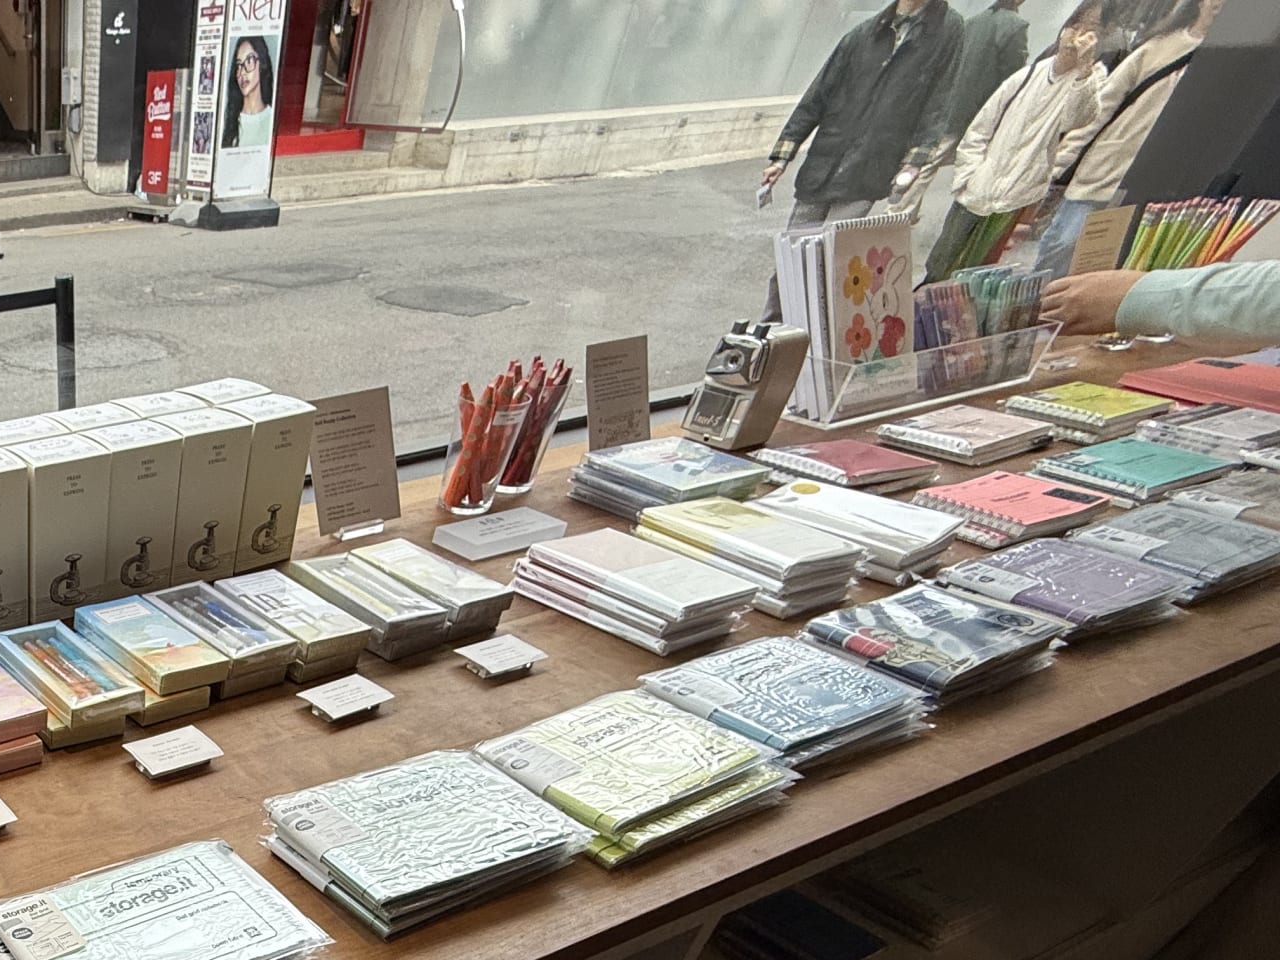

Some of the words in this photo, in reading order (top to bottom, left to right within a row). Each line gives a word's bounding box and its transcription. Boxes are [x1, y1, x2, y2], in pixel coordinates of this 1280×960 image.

[147, 170, 163, 186] 3F
[98, 875, 197, 919] storage.it
[1, 899, 48, 920] storage.it
